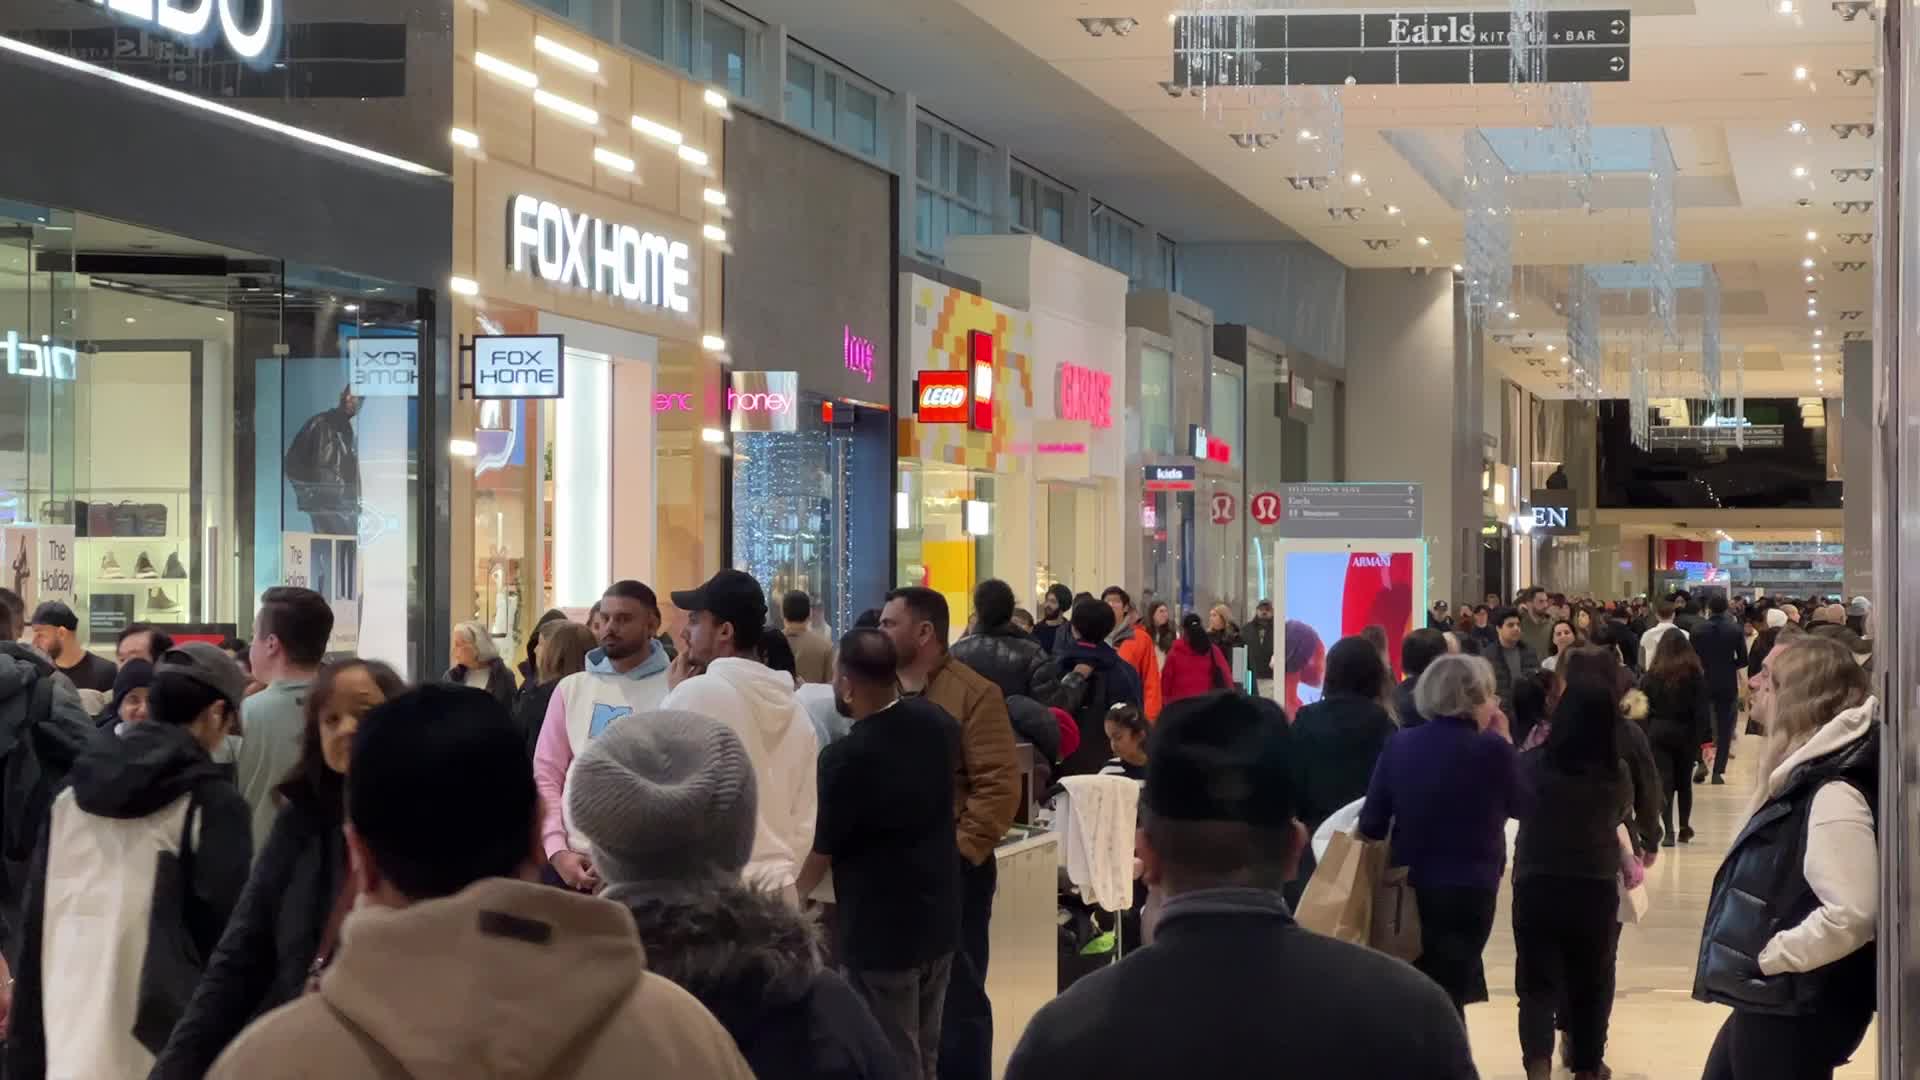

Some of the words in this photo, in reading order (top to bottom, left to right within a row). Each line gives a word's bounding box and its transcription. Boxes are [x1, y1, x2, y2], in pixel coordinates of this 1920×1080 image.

[1388, 16, 1475, 44] Earls
[1566, 30, 1597, 42] BAR
[513, 193, 590, 289] FOX
[594, 217, 689, 313] HOME
[491, 350, 542, 366] FOX
[480, 369, 555, 384] HOME
[727, 387, 794, 415] honey
[921, 385, 967, 408] LEGO
[1061, 361, 1113, 430] GARAGE
[1156, 467, 1183, 480] kids
[48, 540, 66, 561] The
[290, 544, 303, 565] The
[1352, 556, 1392, 568] ARMANI
[41, 567, 74, 594] Holiday
